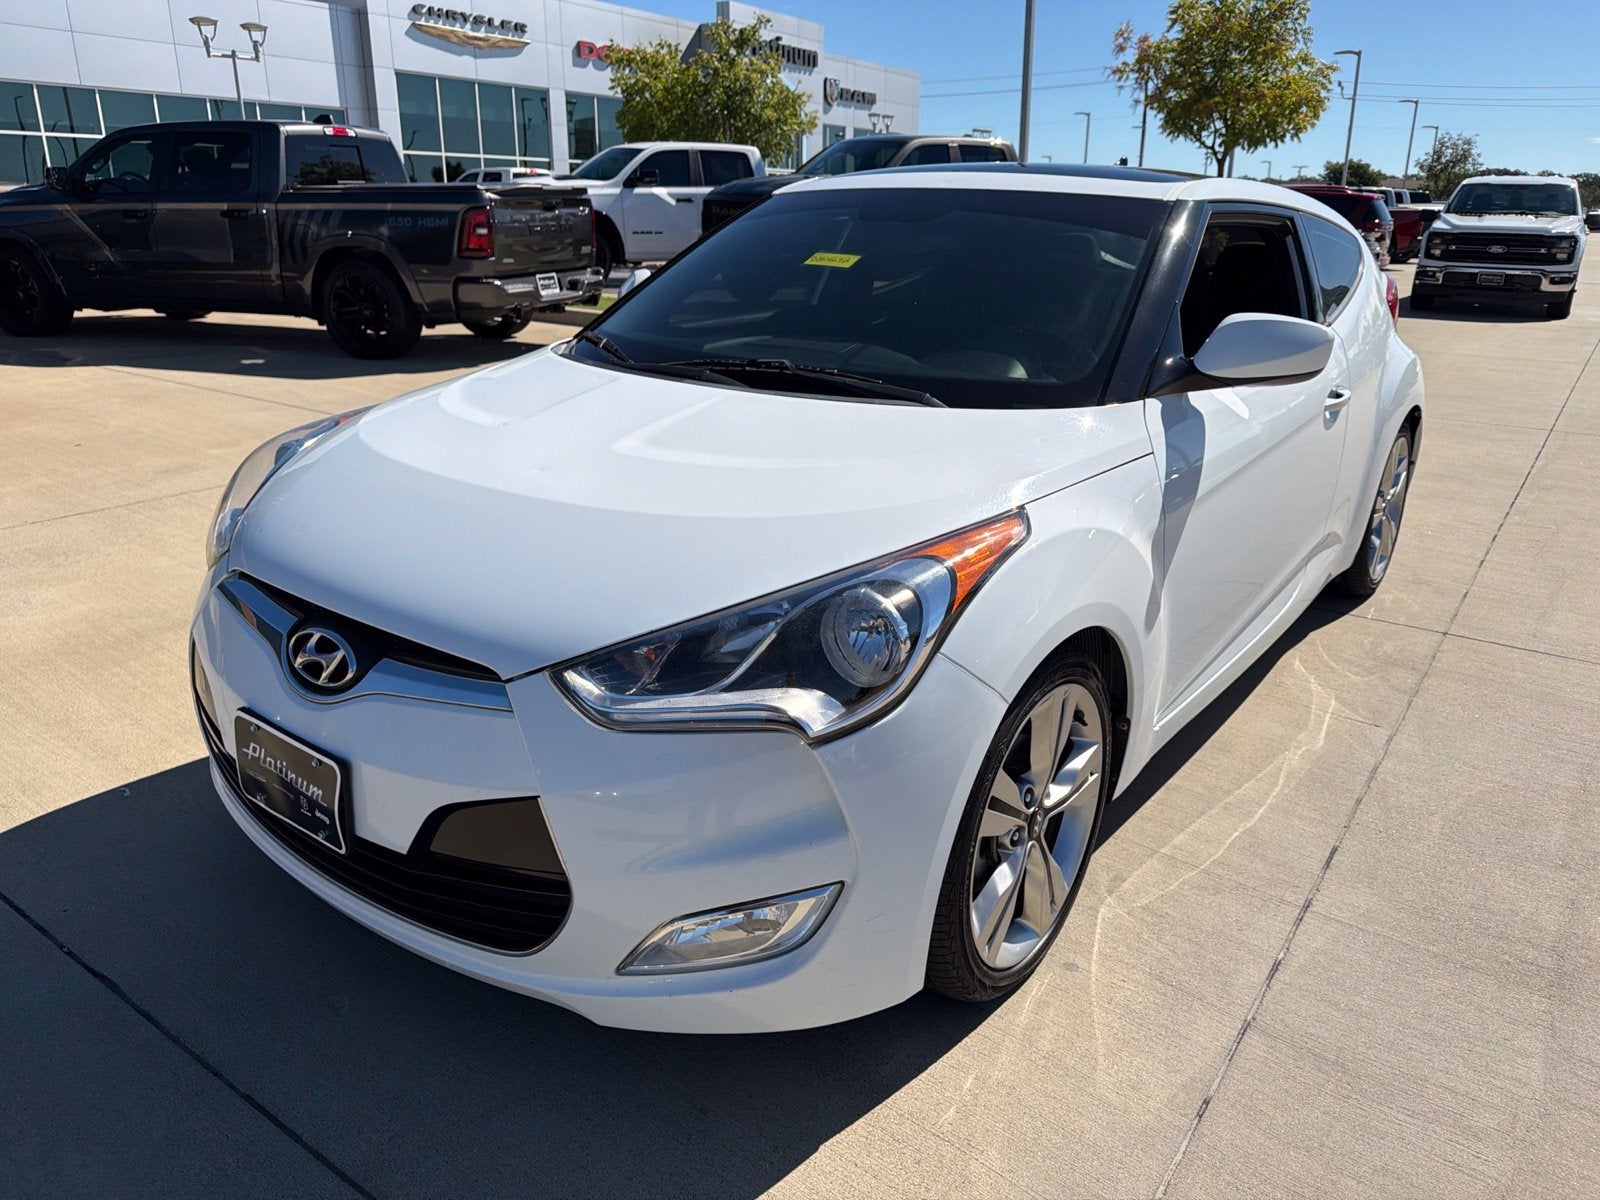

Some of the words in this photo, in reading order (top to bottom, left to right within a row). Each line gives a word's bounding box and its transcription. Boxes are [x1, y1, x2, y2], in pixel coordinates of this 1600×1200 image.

[412, 3, 528, 33] CHRYSLER
[418, 217, 449, 227] HEMI
[242, 742, 327, 807] Platinum
